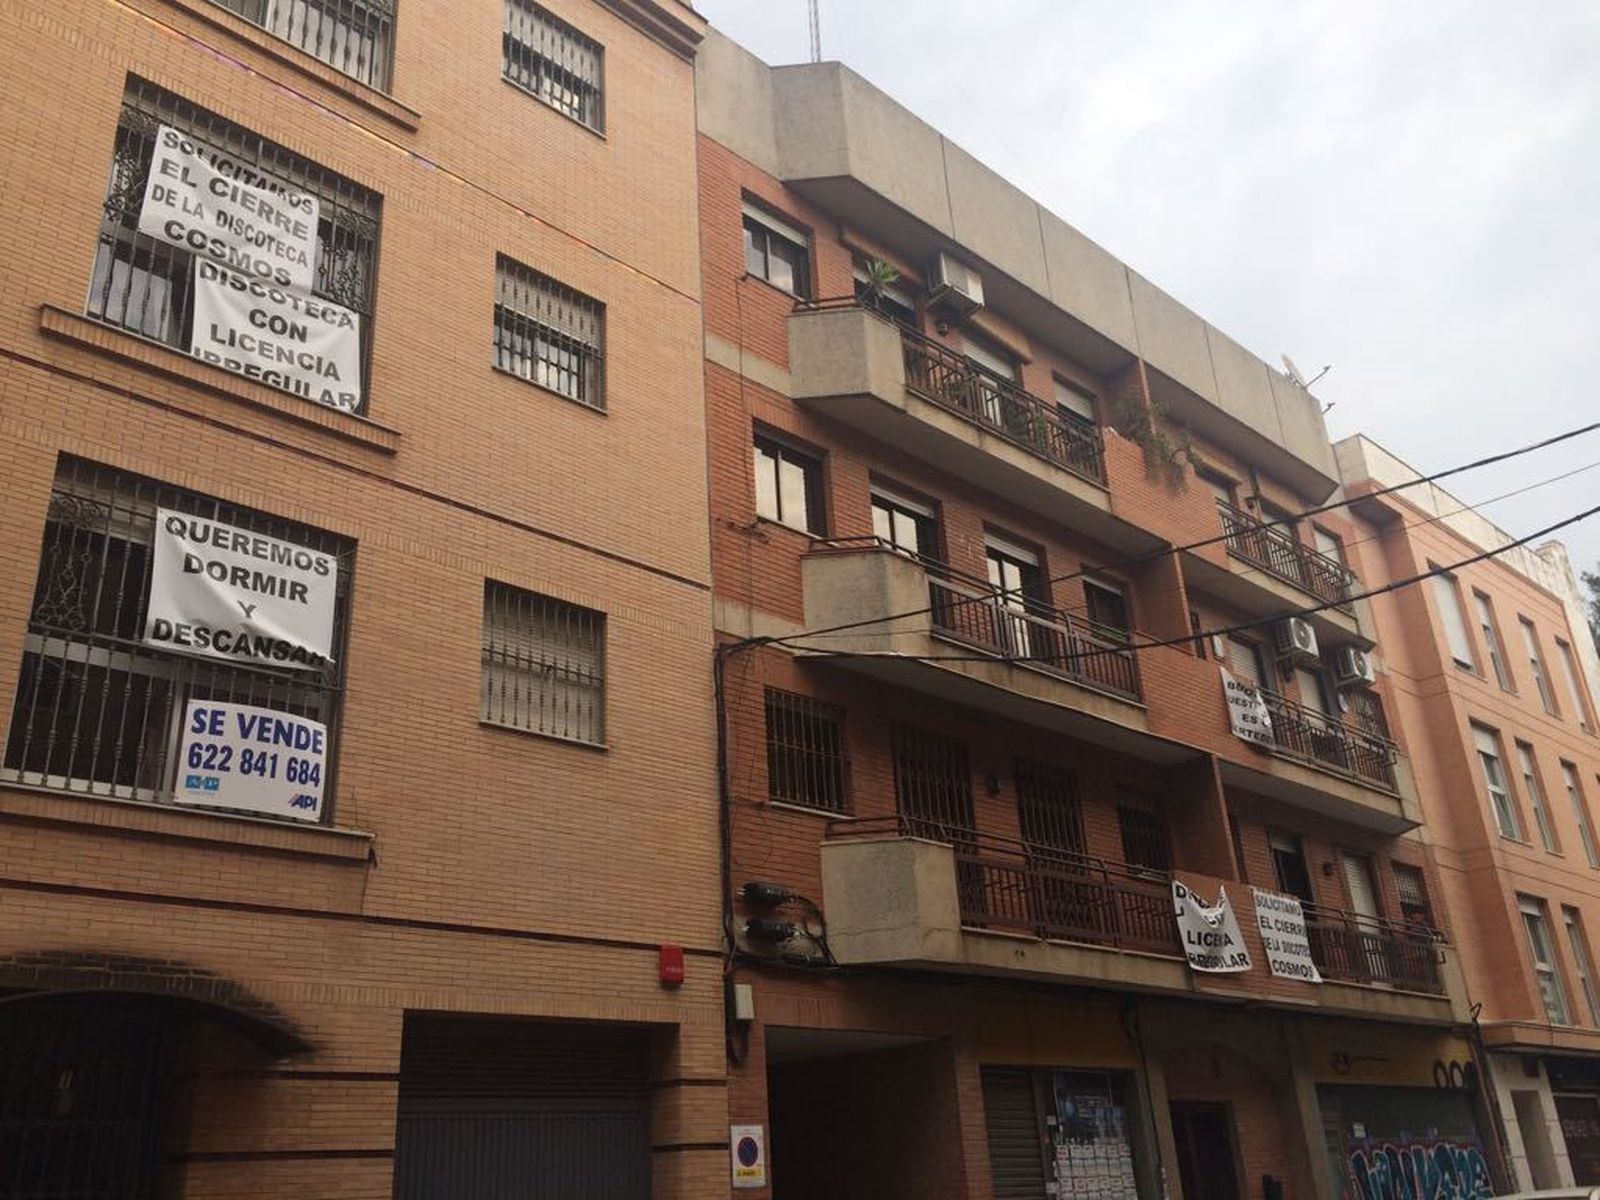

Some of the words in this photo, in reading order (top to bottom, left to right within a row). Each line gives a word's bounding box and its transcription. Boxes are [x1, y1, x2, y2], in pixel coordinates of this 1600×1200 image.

[151, 184, 178, 208] DE
[182, 196, 205, 220] LA
[216, 209, 309, 268] DISCOTECA
[160, 158, 197, 188] EL
[208, 177, 309, 241] CIERRE
[163, 220, 292, 287] COSMOS
[200, 261, 354, 331] DISCOTECA
[210, 323, 341, 382] LICENCIA
[248, 308, 308, 344] CON
[164, 515, 330, 577] QUEREMOS
[183, 552, 308, 605] DORMIR
[236, 600, 257, 619] Y
[190, 708, 226, 736] SE
[236, 712, 323, 755] VENDE
[187, 742, 231, 773] 622
[239, 749, 279, 780] 841
[286, 756, 321, 788] 684
[1260, 916, 1273, 930] EL
[1272, 959, 1314, 978] COSMOS
